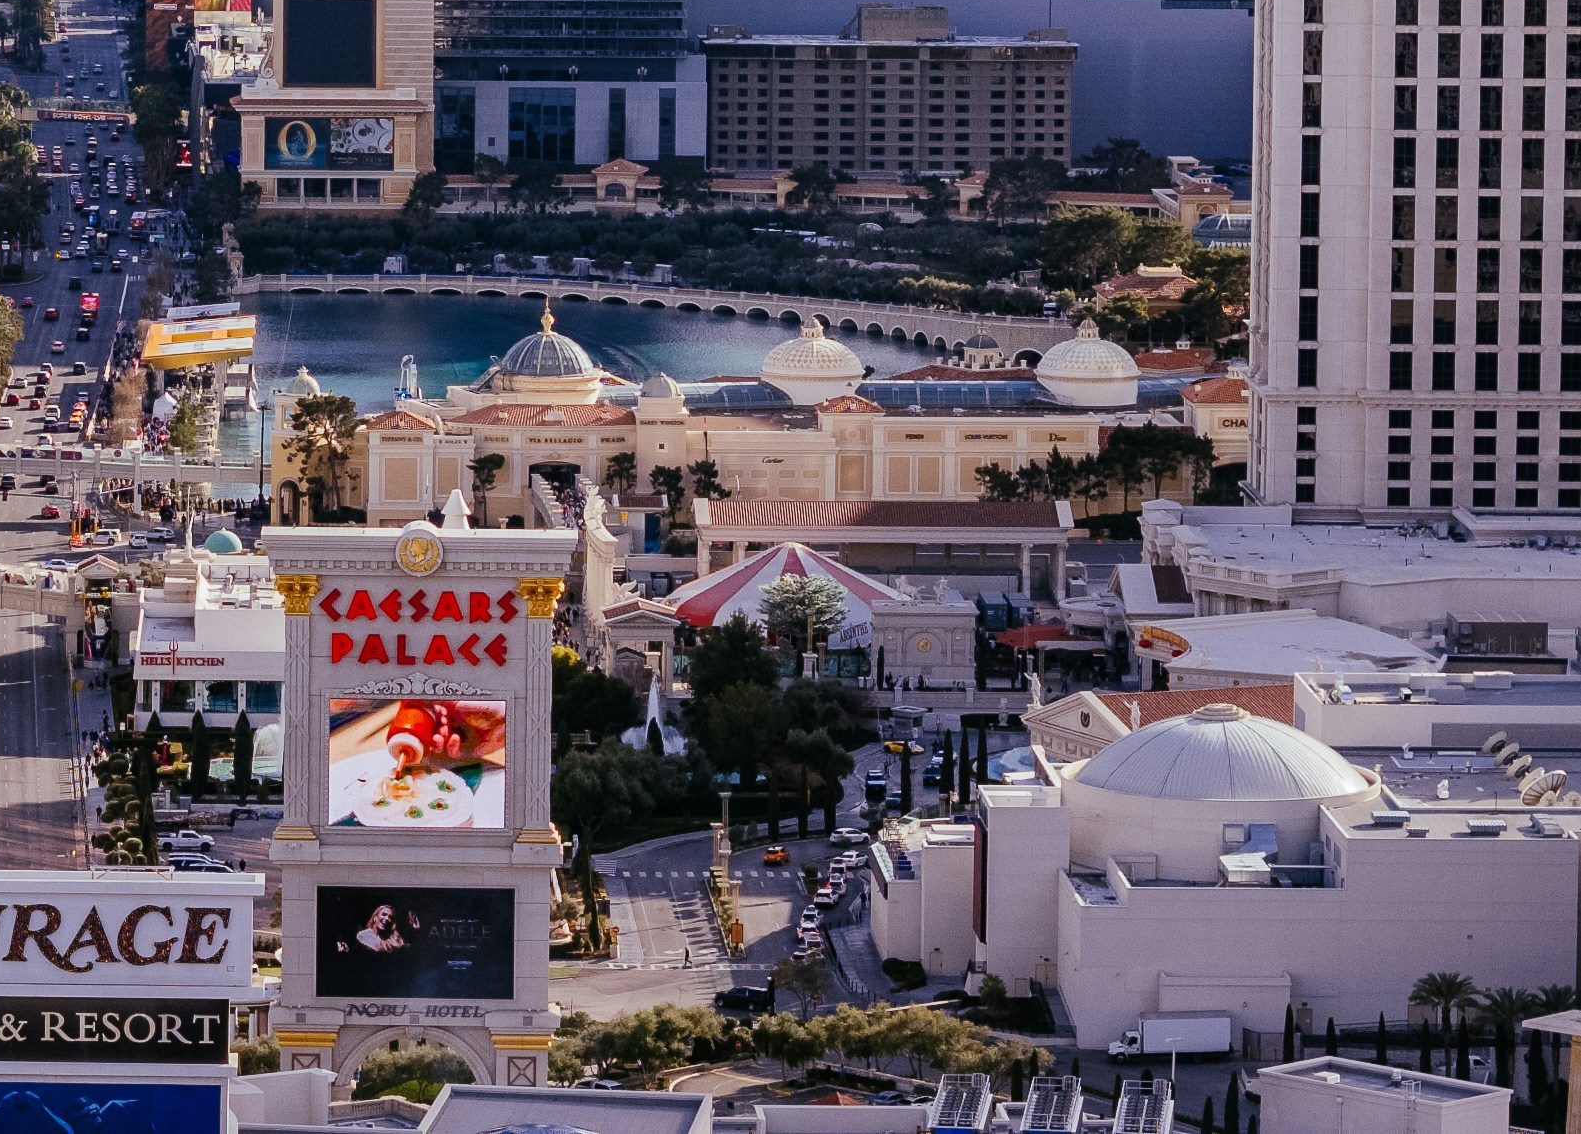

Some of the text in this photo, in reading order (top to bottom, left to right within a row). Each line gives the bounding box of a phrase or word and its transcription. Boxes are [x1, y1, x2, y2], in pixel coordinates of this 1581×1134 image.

[1222, 419, 1249, 428] CHA
[319, 587, 520, 624] CAESARS
[840, 621, 869, 643] ABSINTHE
[331, 632, 508, 667] PALACE
[176, 656, 225, 667] KITCHEN
[428, 925, 492, 939] ADELE
[347, 1003, 485, 1018] NOBU HOTEL
[40, 1011, 221, 1046] RESORT
